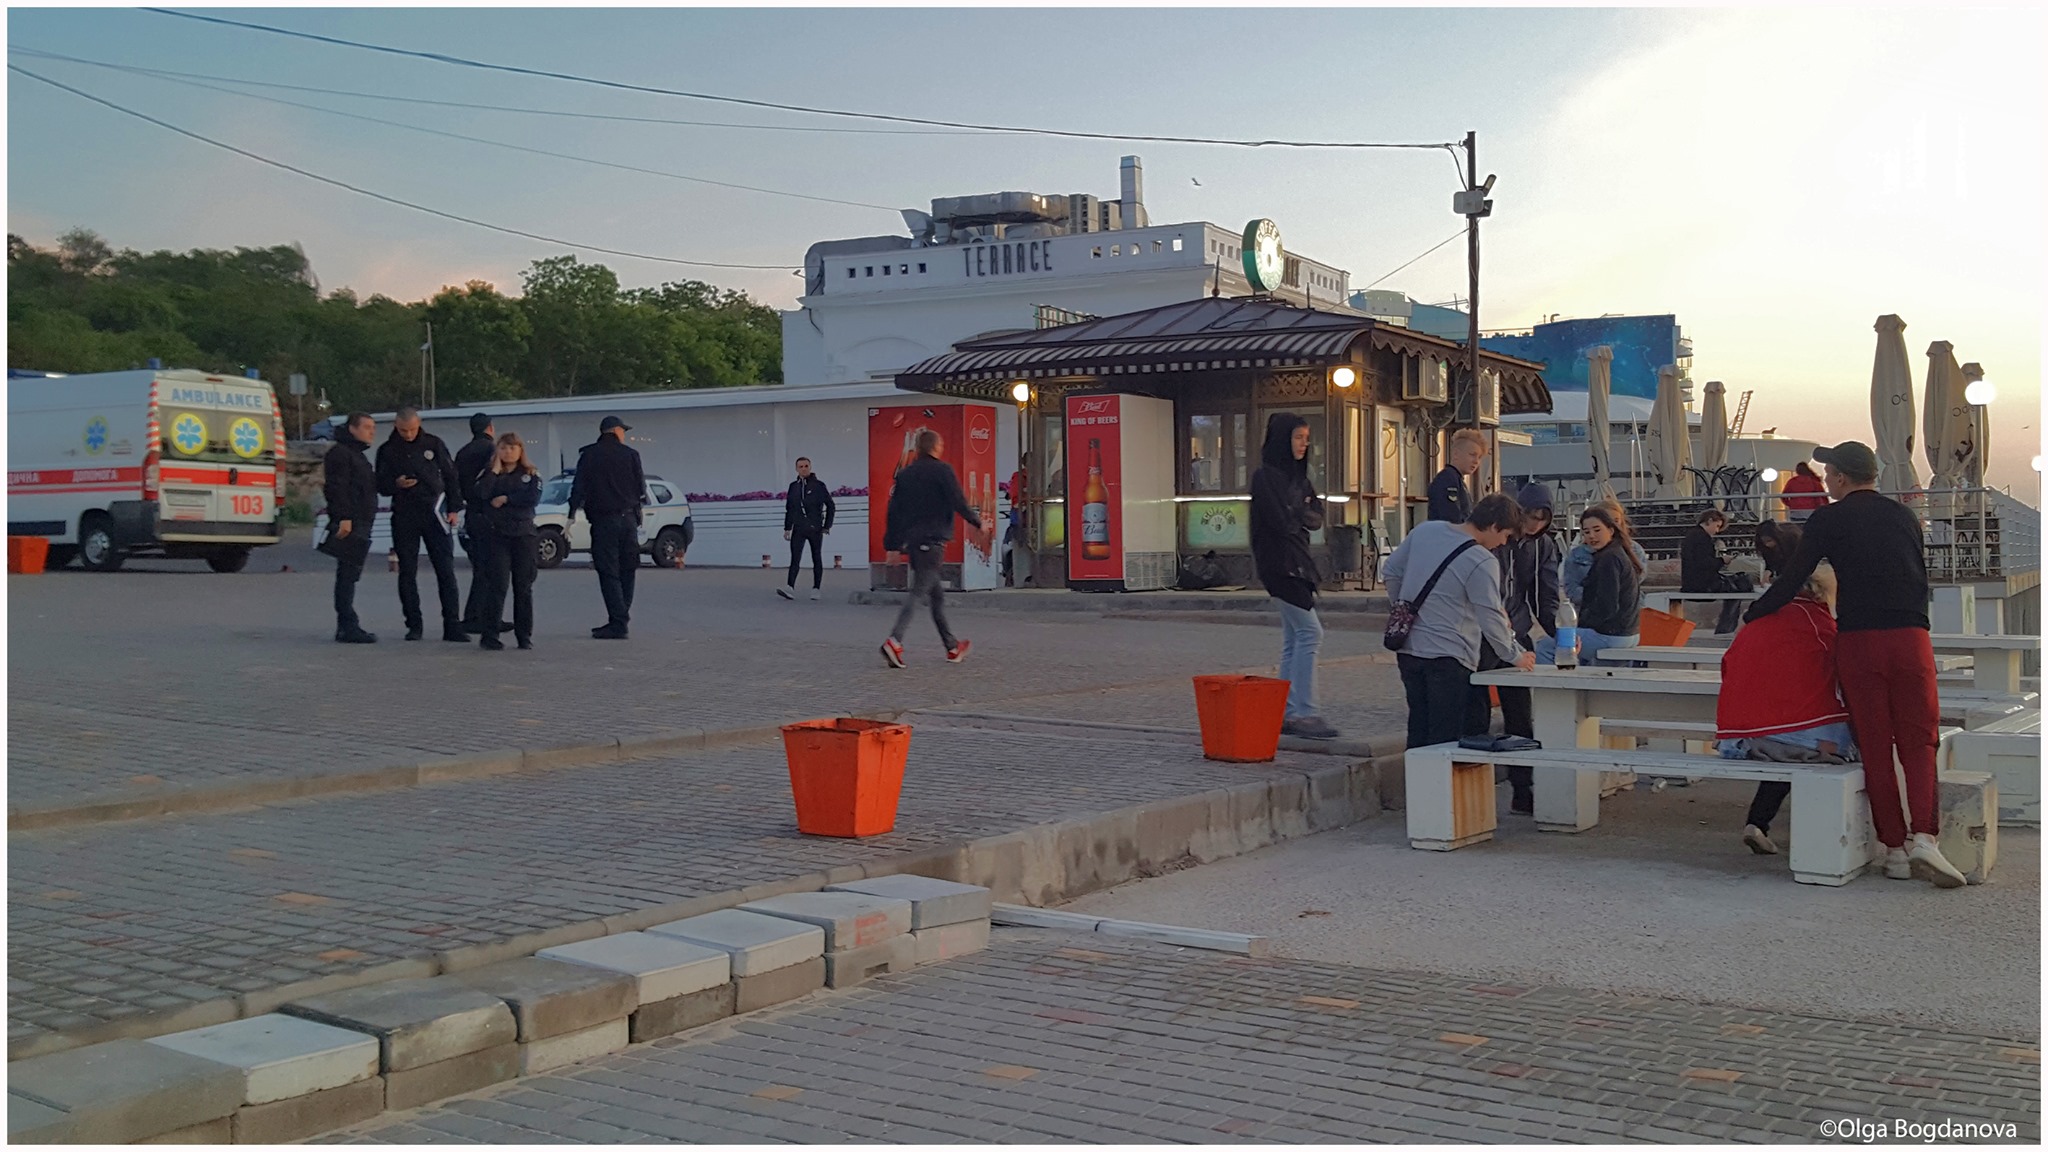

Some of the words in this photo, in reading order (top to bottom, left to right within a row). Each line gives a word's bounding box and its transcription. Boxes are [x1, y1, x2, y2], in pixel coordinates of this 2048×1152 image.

[962, 240, 1052, 277] TERRACE
[172, 388, 262, 407] AMBULANCE
[1097, 416, 1118, 424] BEERS
[230, 495, 264, 515] 103
